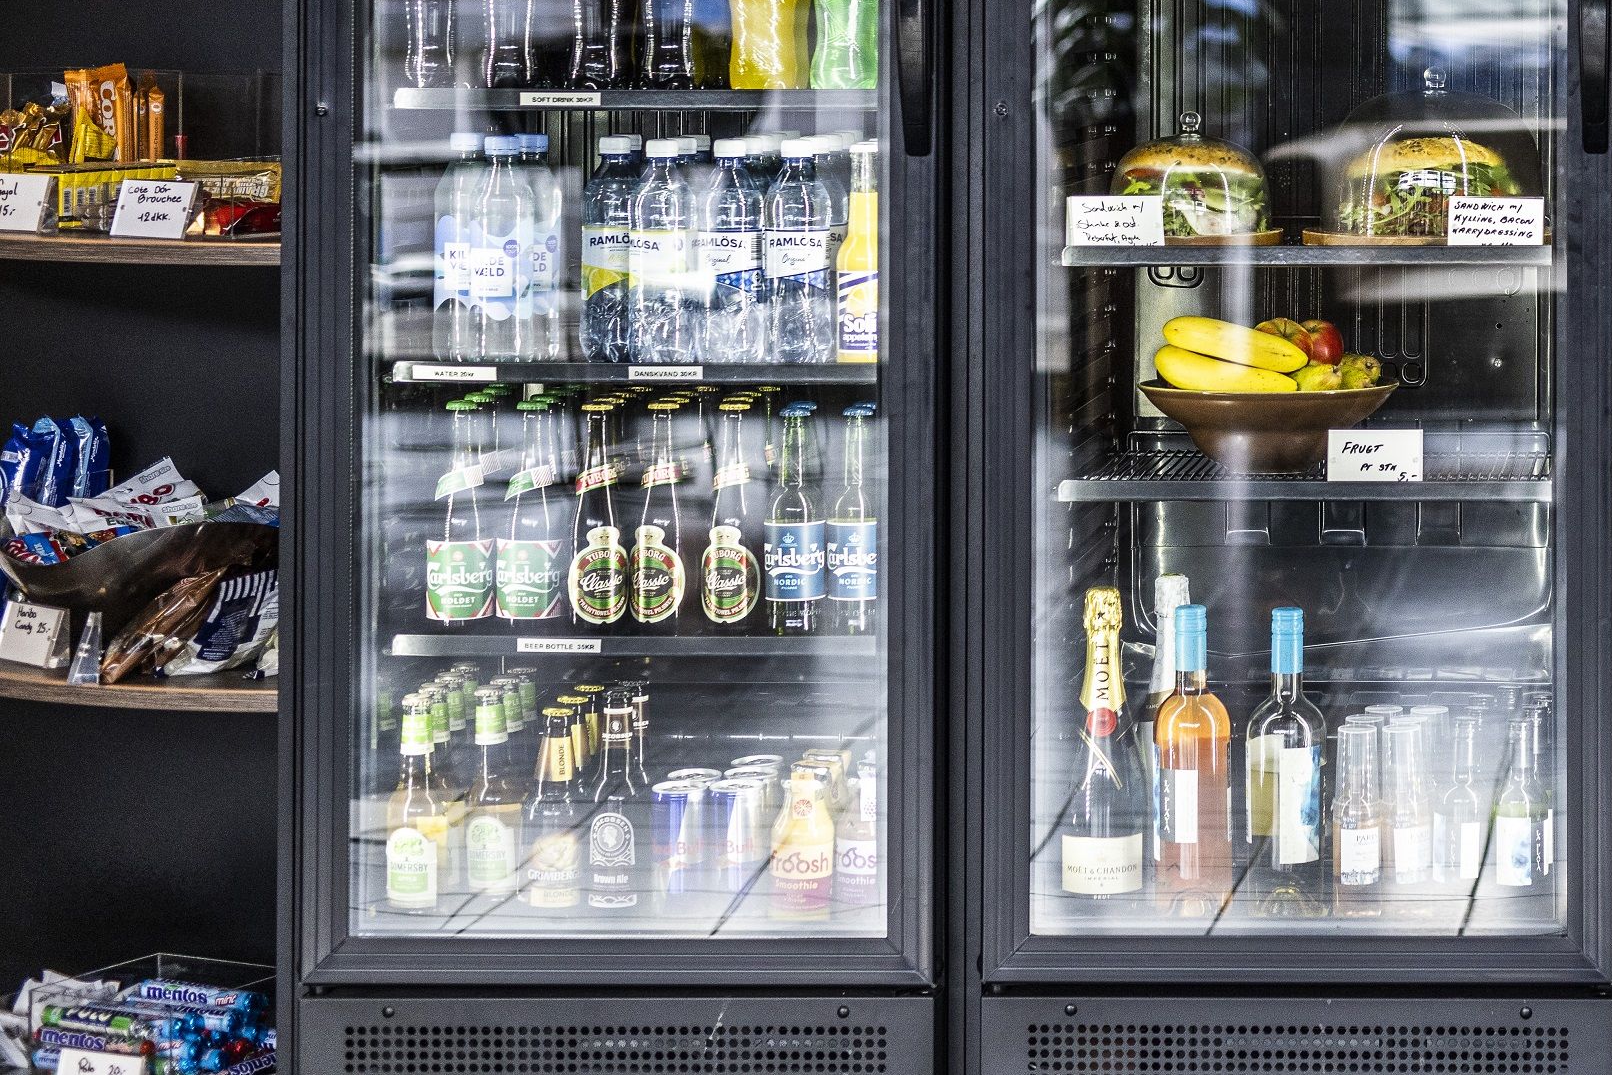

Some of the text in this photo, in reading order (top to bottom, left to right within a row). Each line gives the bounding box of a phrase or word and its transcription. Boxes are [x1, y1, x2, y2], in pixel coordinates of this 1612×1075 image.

[1500, 216, 1535, 225] BACON
[1342, 441, 1384, 454] FRUGT
[764, 543, 826, 571] Carlsberg
[827, 543, 877, 571] Carlsbe
[427, 561, 493, 590] Carlsberg
[496, 560, 560, 589] Carlsberg
[580, 572, 623, 592] Classic
[705, 571, 746, 590] Classic
[773, 578, 807, 586] NORDIC
[527, 869, 579, 882] GRIMBERG
[1096, 864, 1137, 874] CHANDON
[774, 880, 819, 890] Smoothie
[146, 984, 208, 1005] mentos
[40, 1028, 107, 1051] mentos
